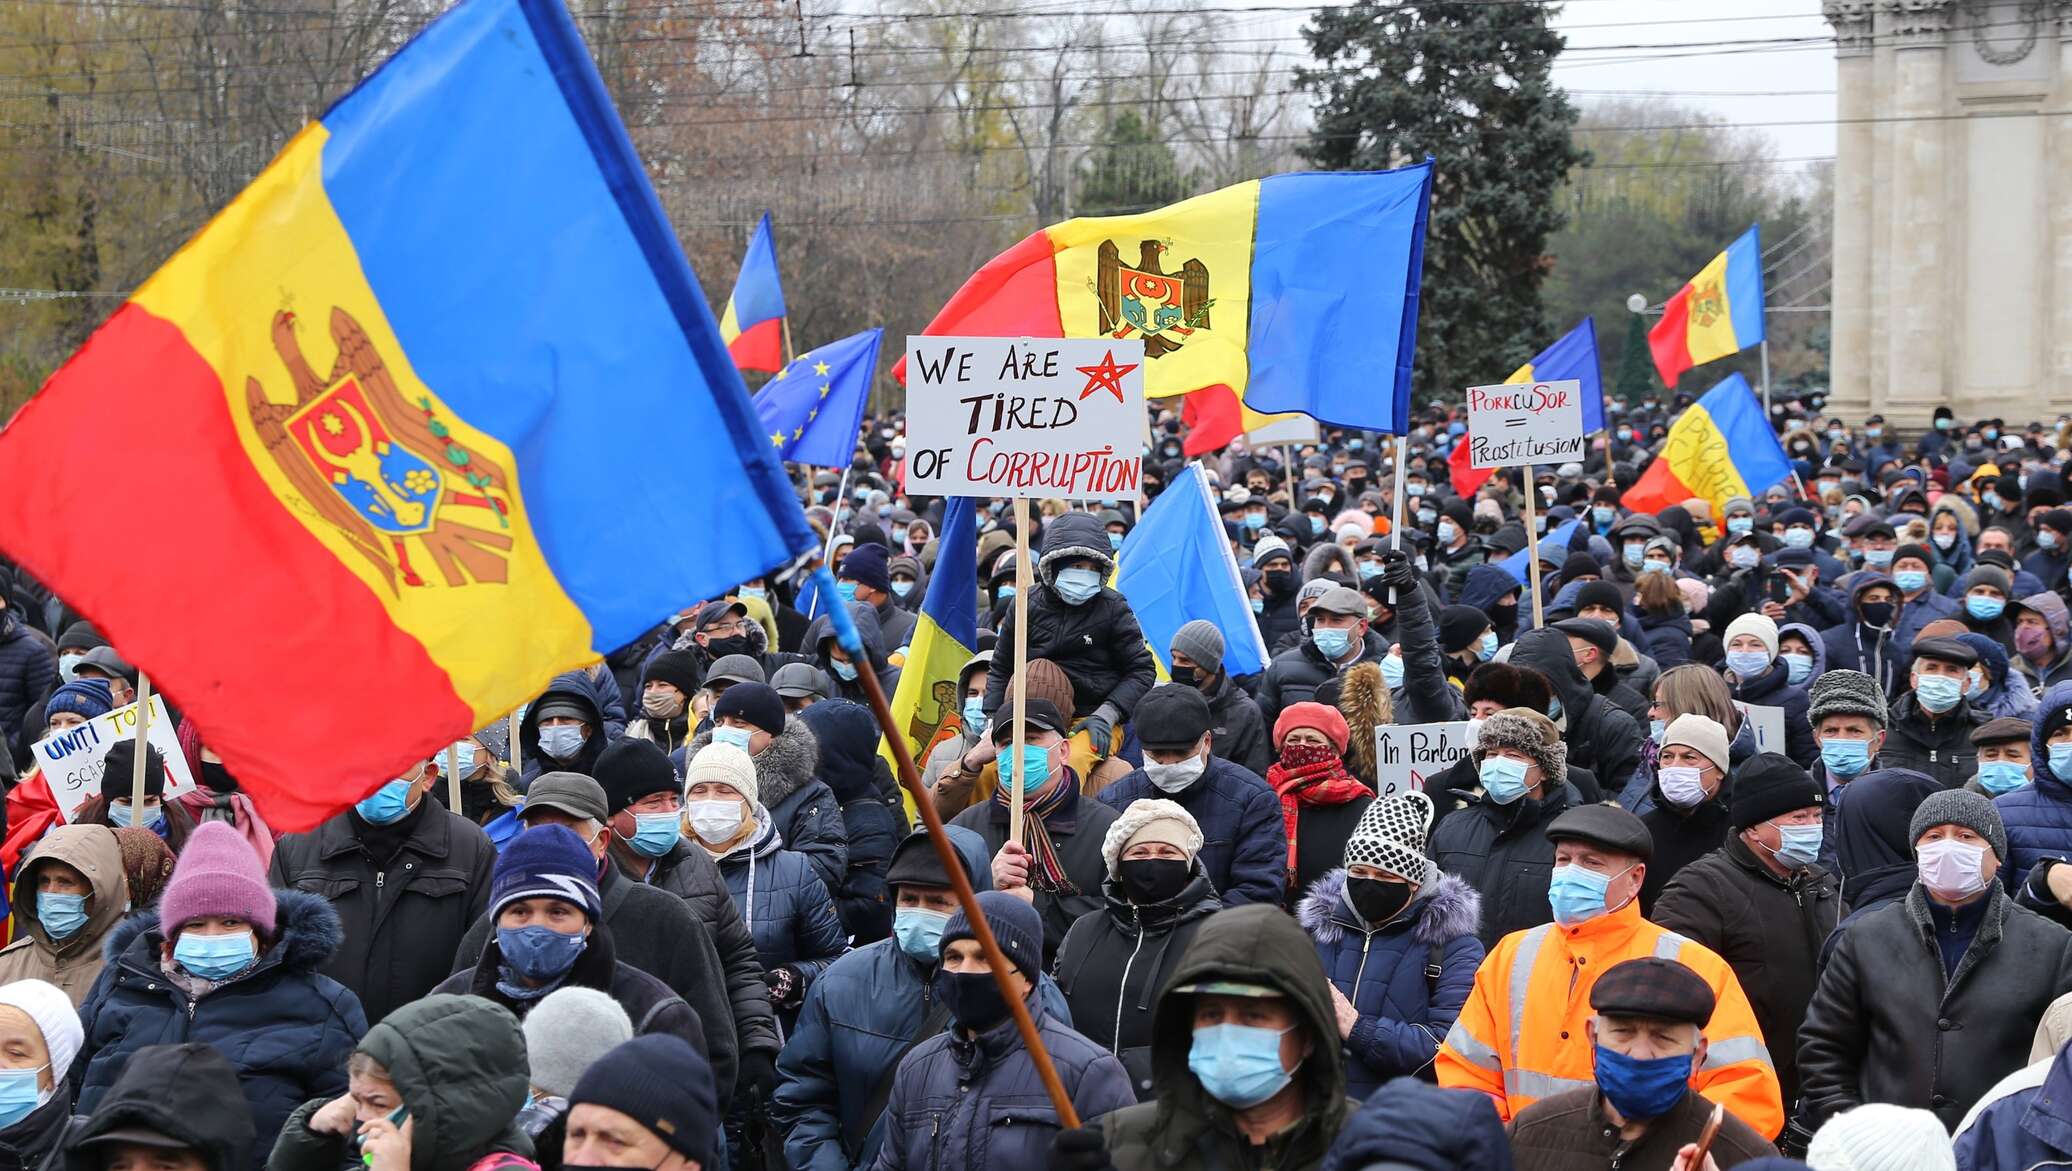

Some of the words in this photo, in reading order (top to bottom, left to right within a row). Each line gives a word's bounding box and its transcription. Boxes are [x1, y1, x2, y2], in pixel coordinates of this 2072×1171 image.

[916, 347, 973, 384] WE
[999, 344, 1059, 380] ARE
[913, 448, 952, 479] OF
[106, 698, 156, 734] TOI
[1380, 732, 1399, 764] În
